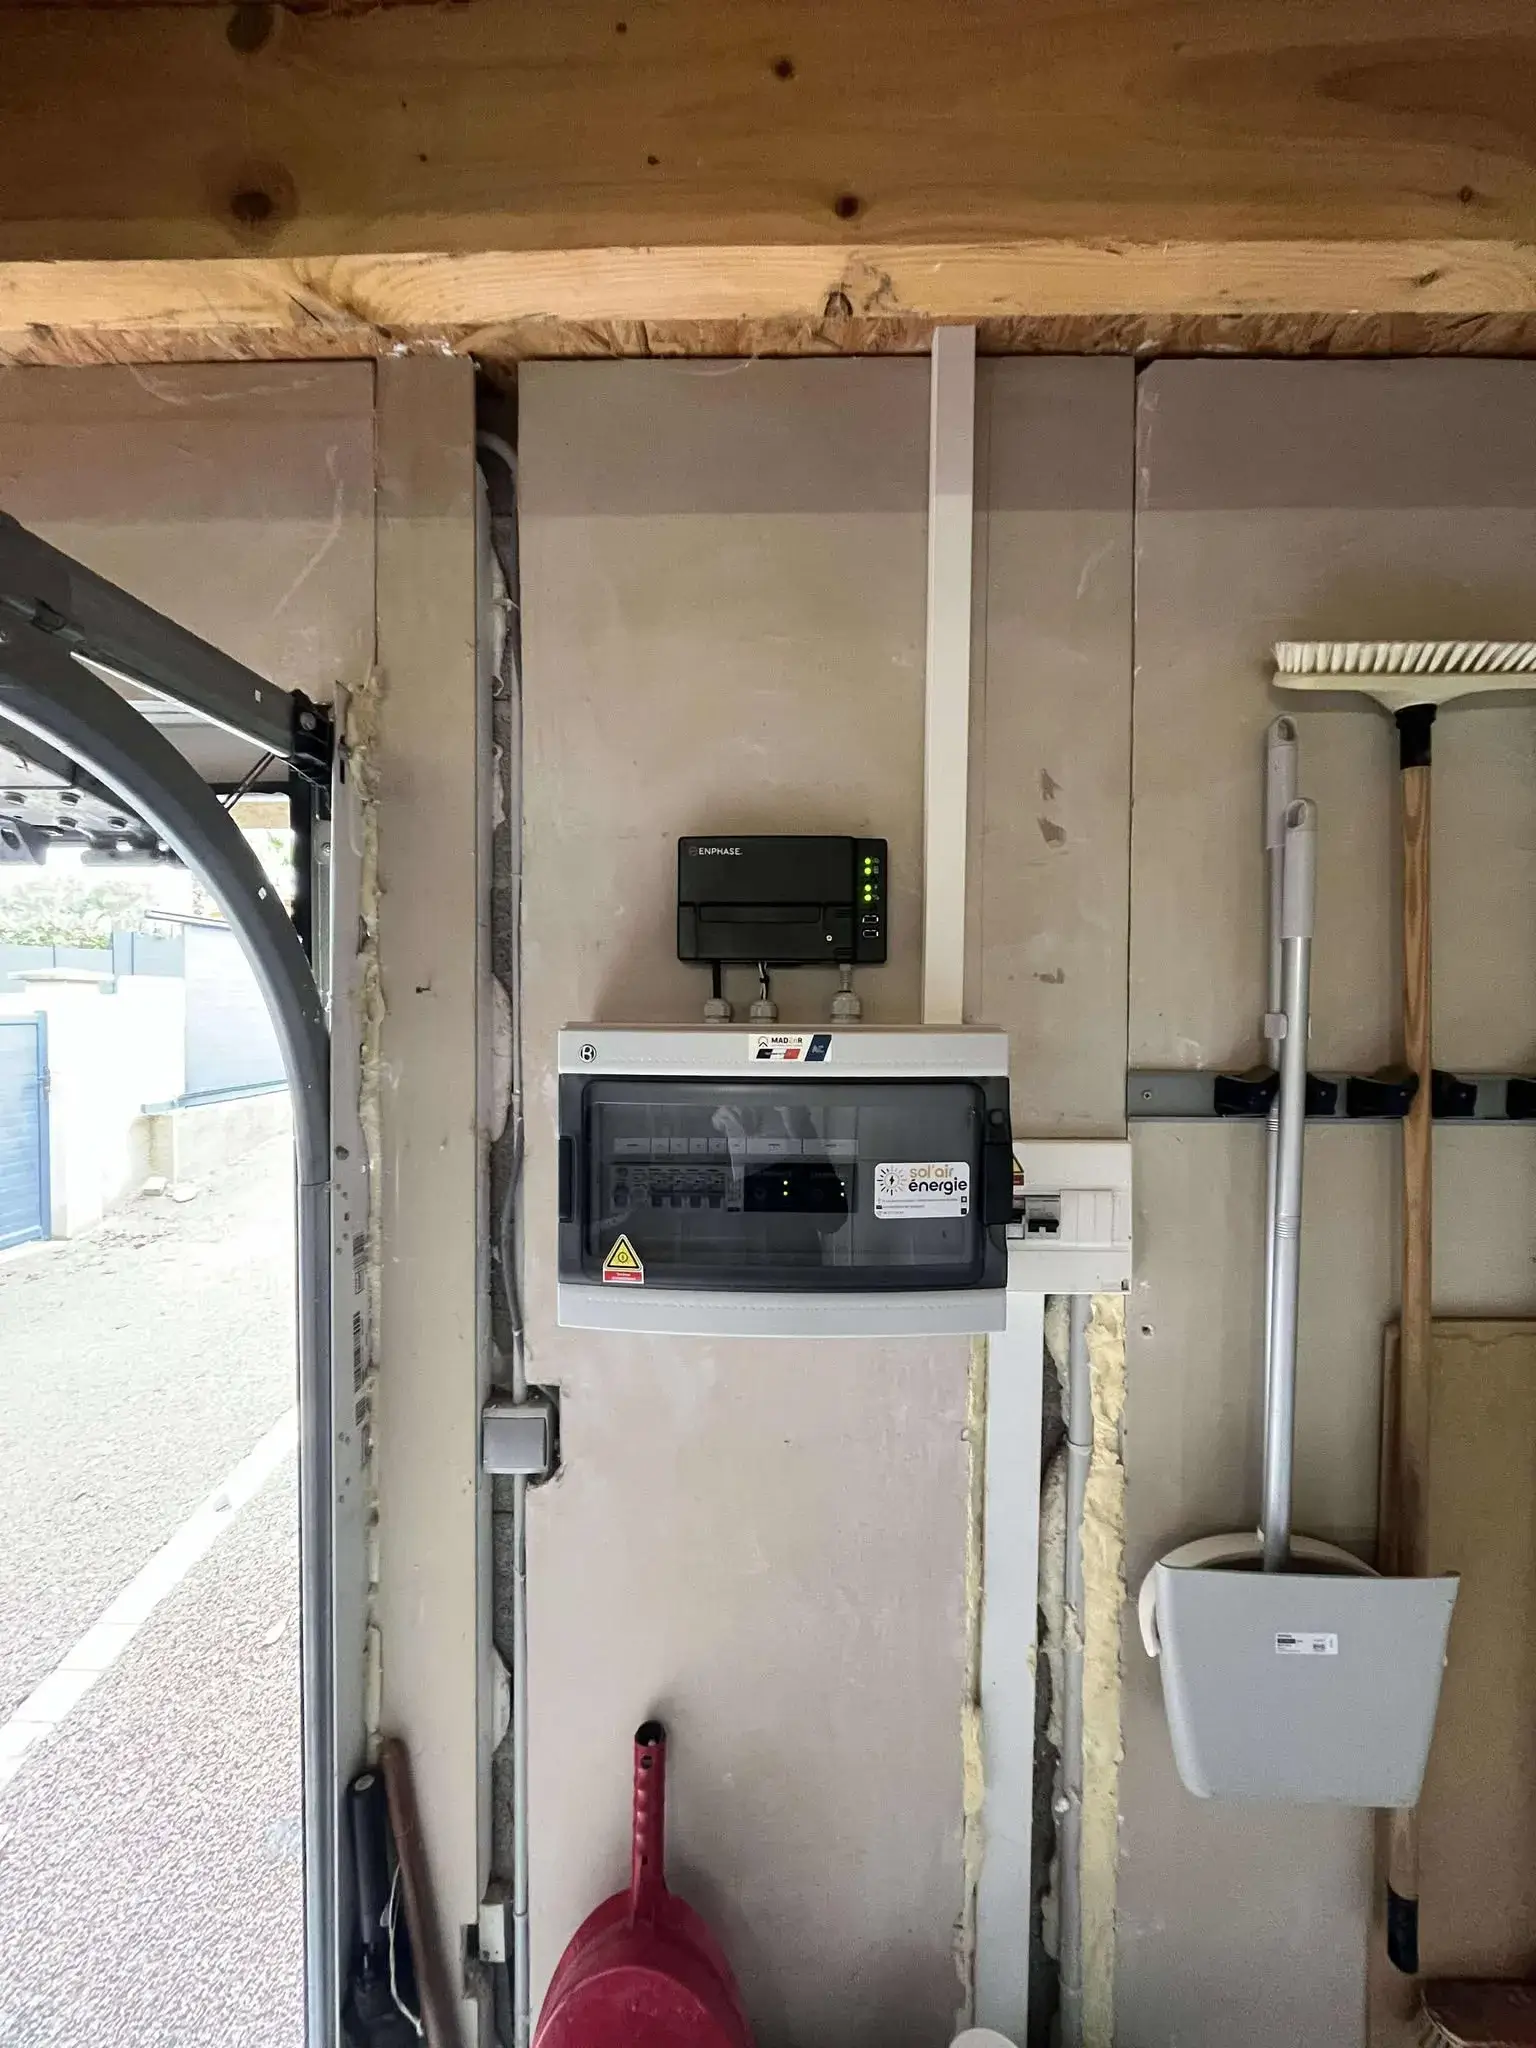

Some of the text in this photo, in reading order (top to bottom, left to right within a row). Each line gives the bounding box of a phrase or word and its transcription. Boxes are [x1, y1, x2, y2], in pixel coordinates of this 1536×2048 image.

[698, 847, 741, 856] ENPHASE
[909, 1164, 954, 1178] sol'air
[908, 1177, 967, 1195] énergie
